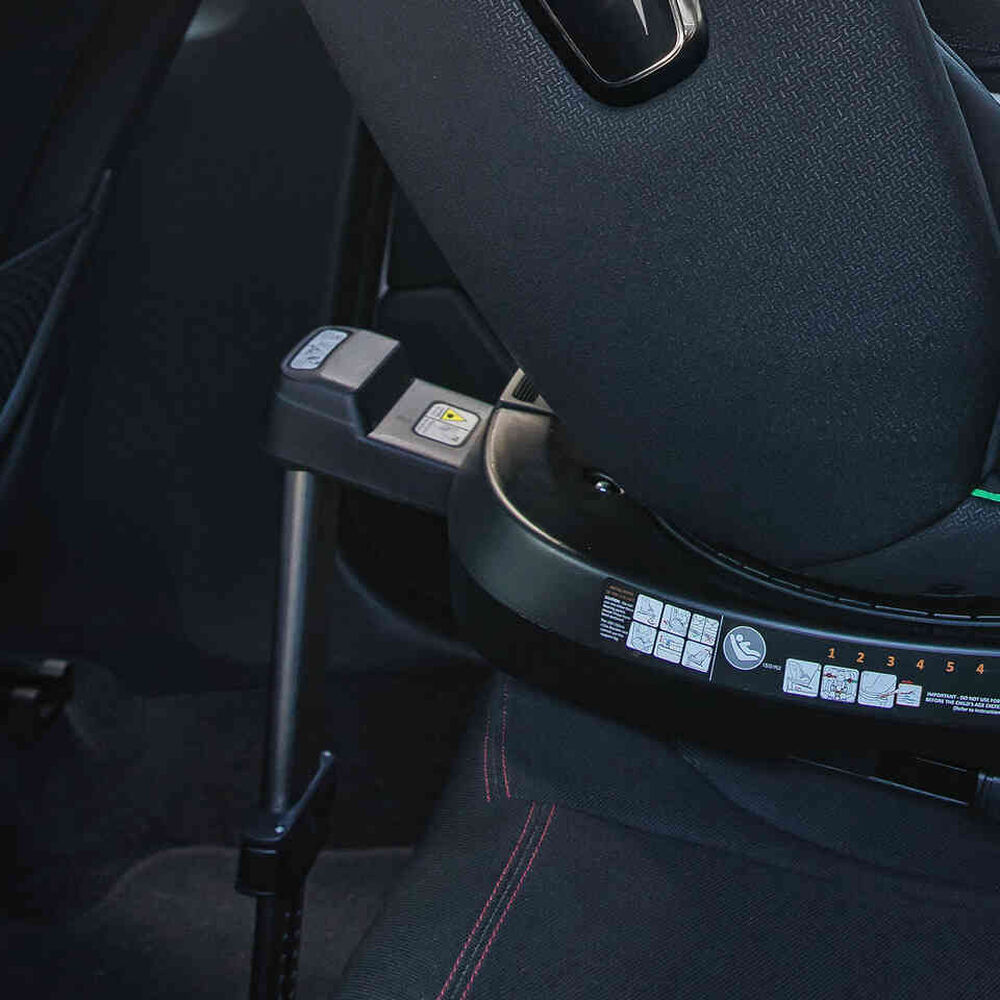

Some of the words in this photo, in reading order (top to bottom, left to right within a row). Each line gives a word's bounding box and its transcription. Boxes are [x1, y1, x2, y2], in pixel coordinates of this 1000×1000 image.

[828, 647, 835, 659] 1
[856, 652, 865, 664] 2
[887, 655, 896, 668] 3
[916, 658, 925, 671] 4
[945, 661, 955, 673] 5
[976, 663, 984, 674] 4
